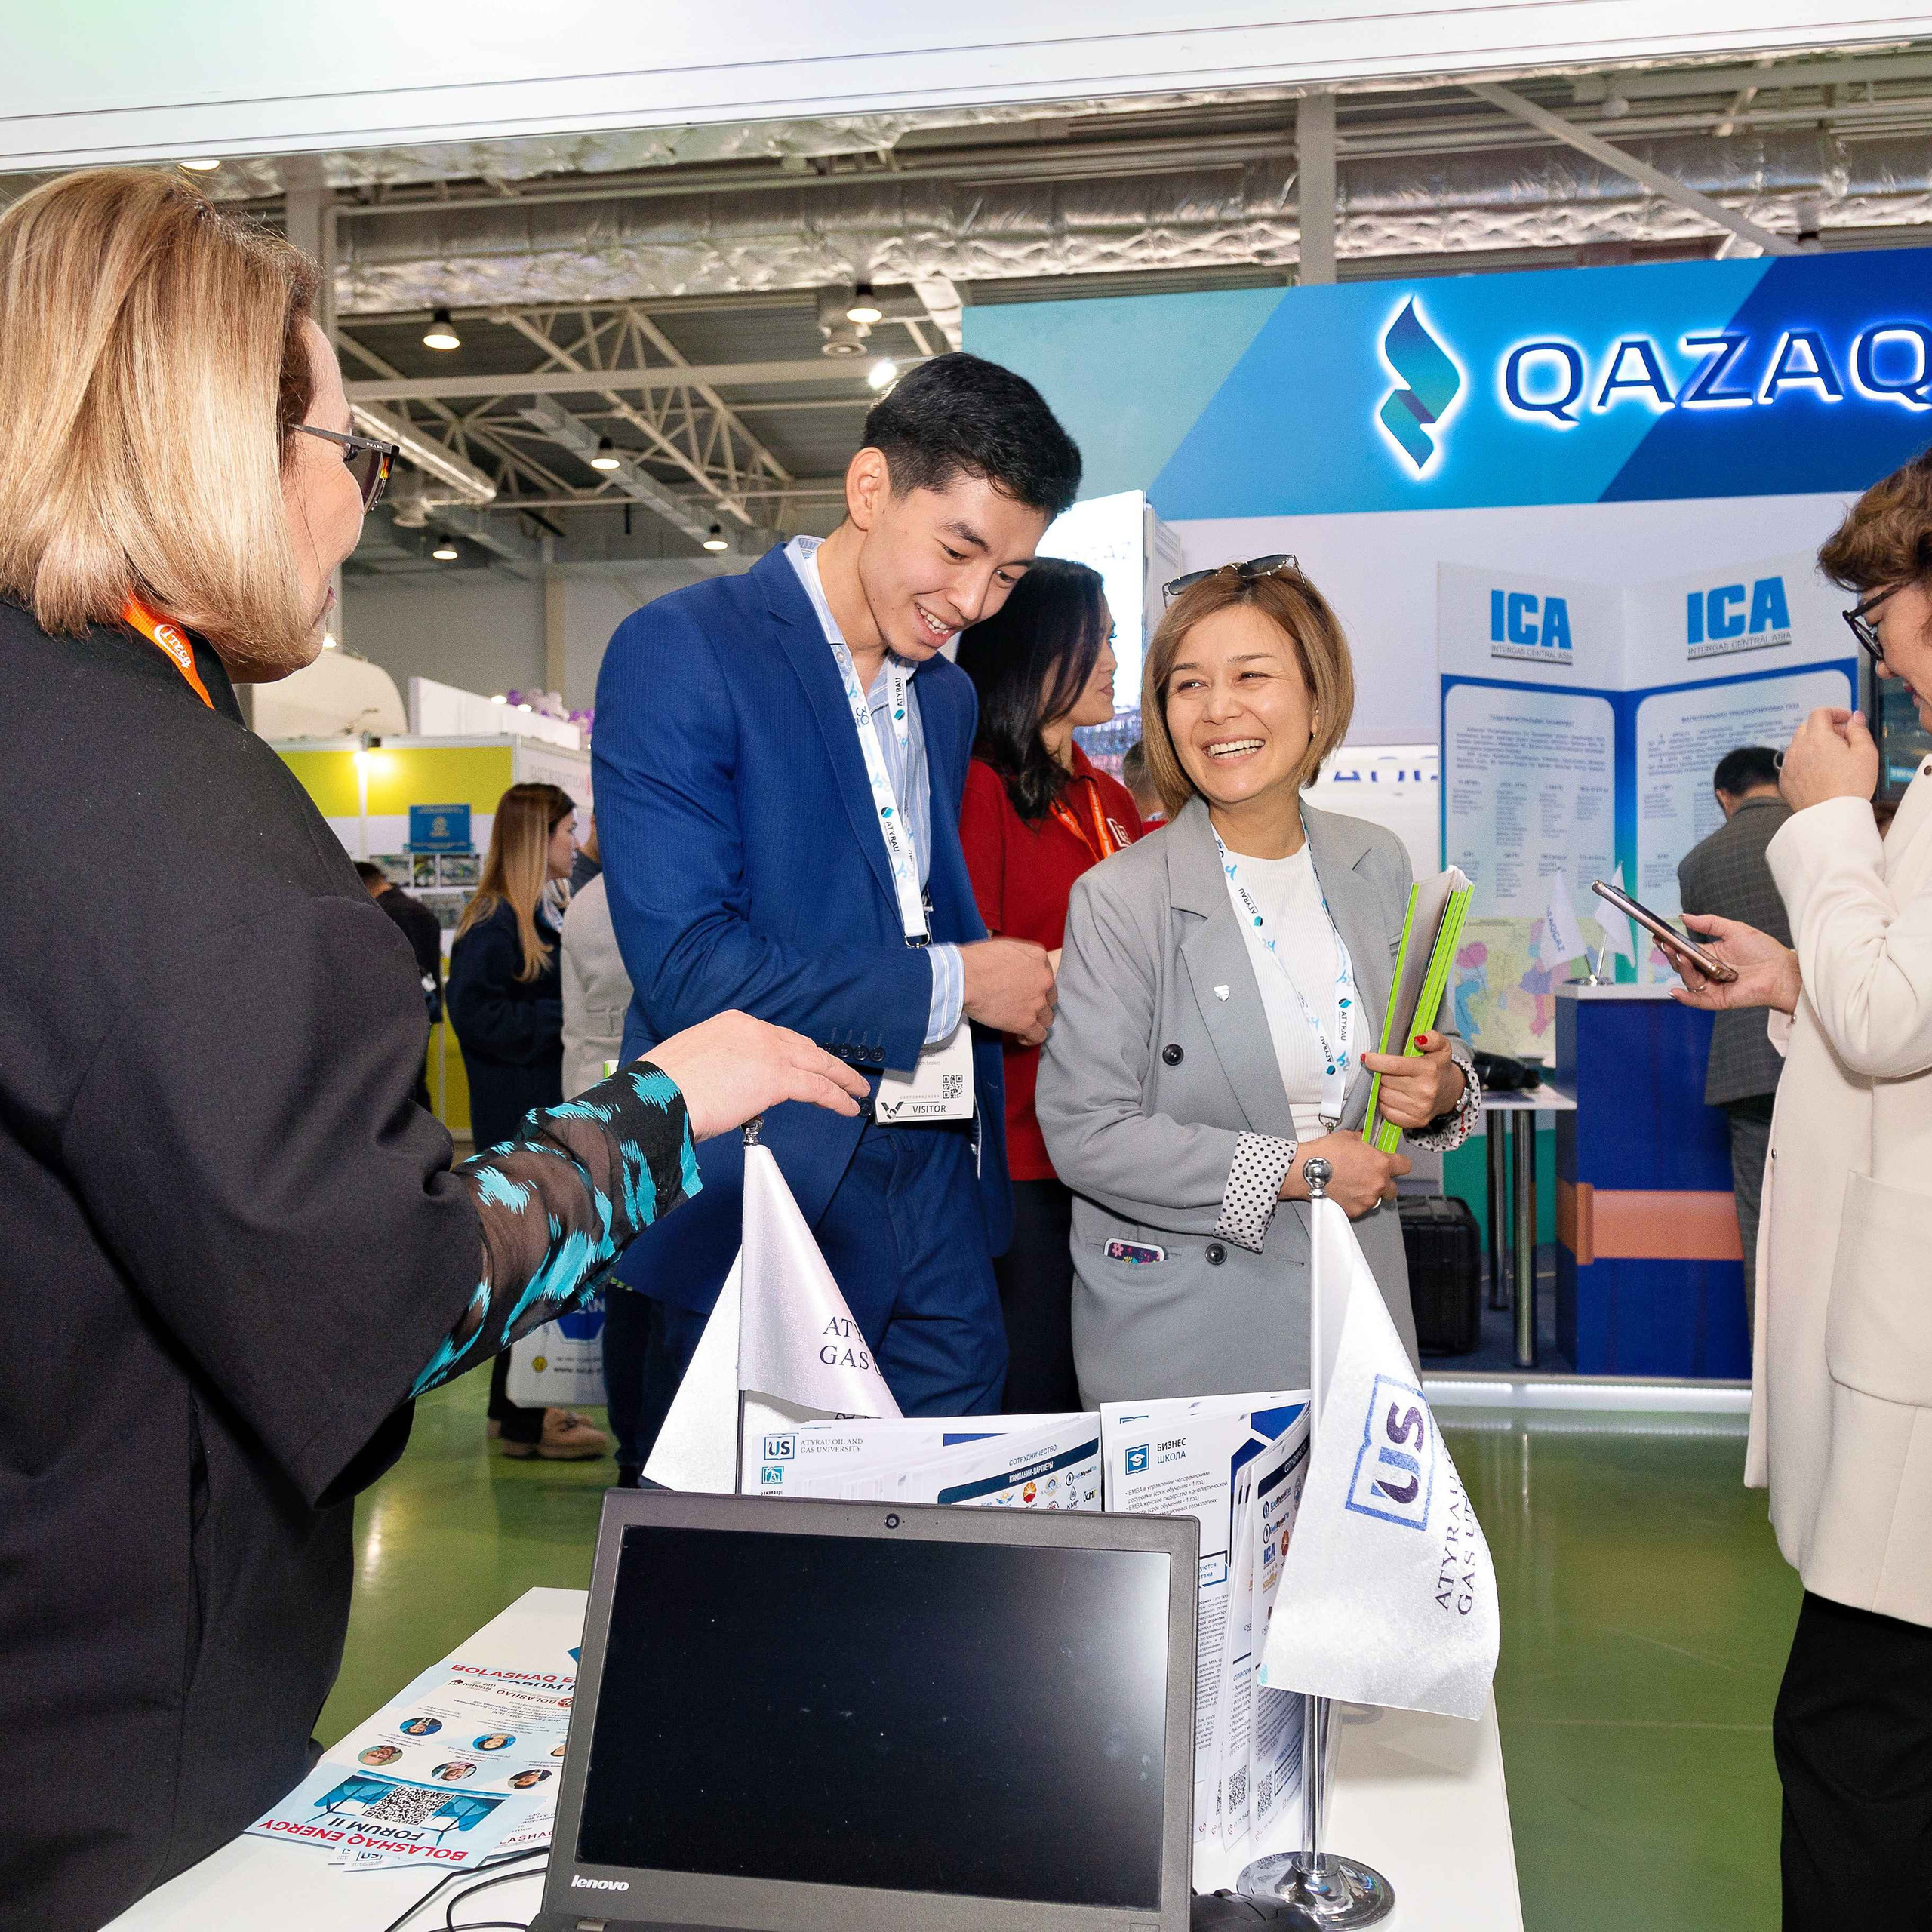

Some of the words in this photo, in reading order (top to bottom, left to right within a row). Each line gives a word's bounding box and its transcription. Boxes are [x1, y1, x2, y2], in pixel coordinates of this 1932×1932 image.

[1506, 323, 1932, 426] QAZAQ
[1491, 589, 1572, 649] ICA
[1687, 577, 1790, 645] ICA
[1731, 635, 1768, 649] CENTRAL
[1772, 632, 1791, 643] ASIA
[885, 821, 900, 853] ATYRAU
[1238, 888, 1257, 915] ATYRAU
[1320, 1036, 1332, 1063] ATYRAU
[912, 1105, 946, 1113] VISITOR
[820, 1345, 869, 1370] GAS
[768, 1441, 790, 1456] US
[1009, 1444, 1057, 1466] СОТРУДНИЧЕСТВО
[1157, 1438, 1186, 1451] БИЗНЕС
[1157, 1451, 1186, 1464] ШКОЛА
[1264, 1542, 1275, 1564] ICA
[1457, 1550, 1475, 1615] GAS
[451, 1664, 558, 1683] BOLASHAQ
[497, 1689, 557, 1704] BOLASHAQ
[257, 1819, 346, 1841] ENERGY
[328, 1817, 344, 1827] II
[345, 1821, 426, 1841] FORUM
[346, 1833, 469, 1862] BOLASHAQ
[571, 1875, 629, 1891] lenovo
